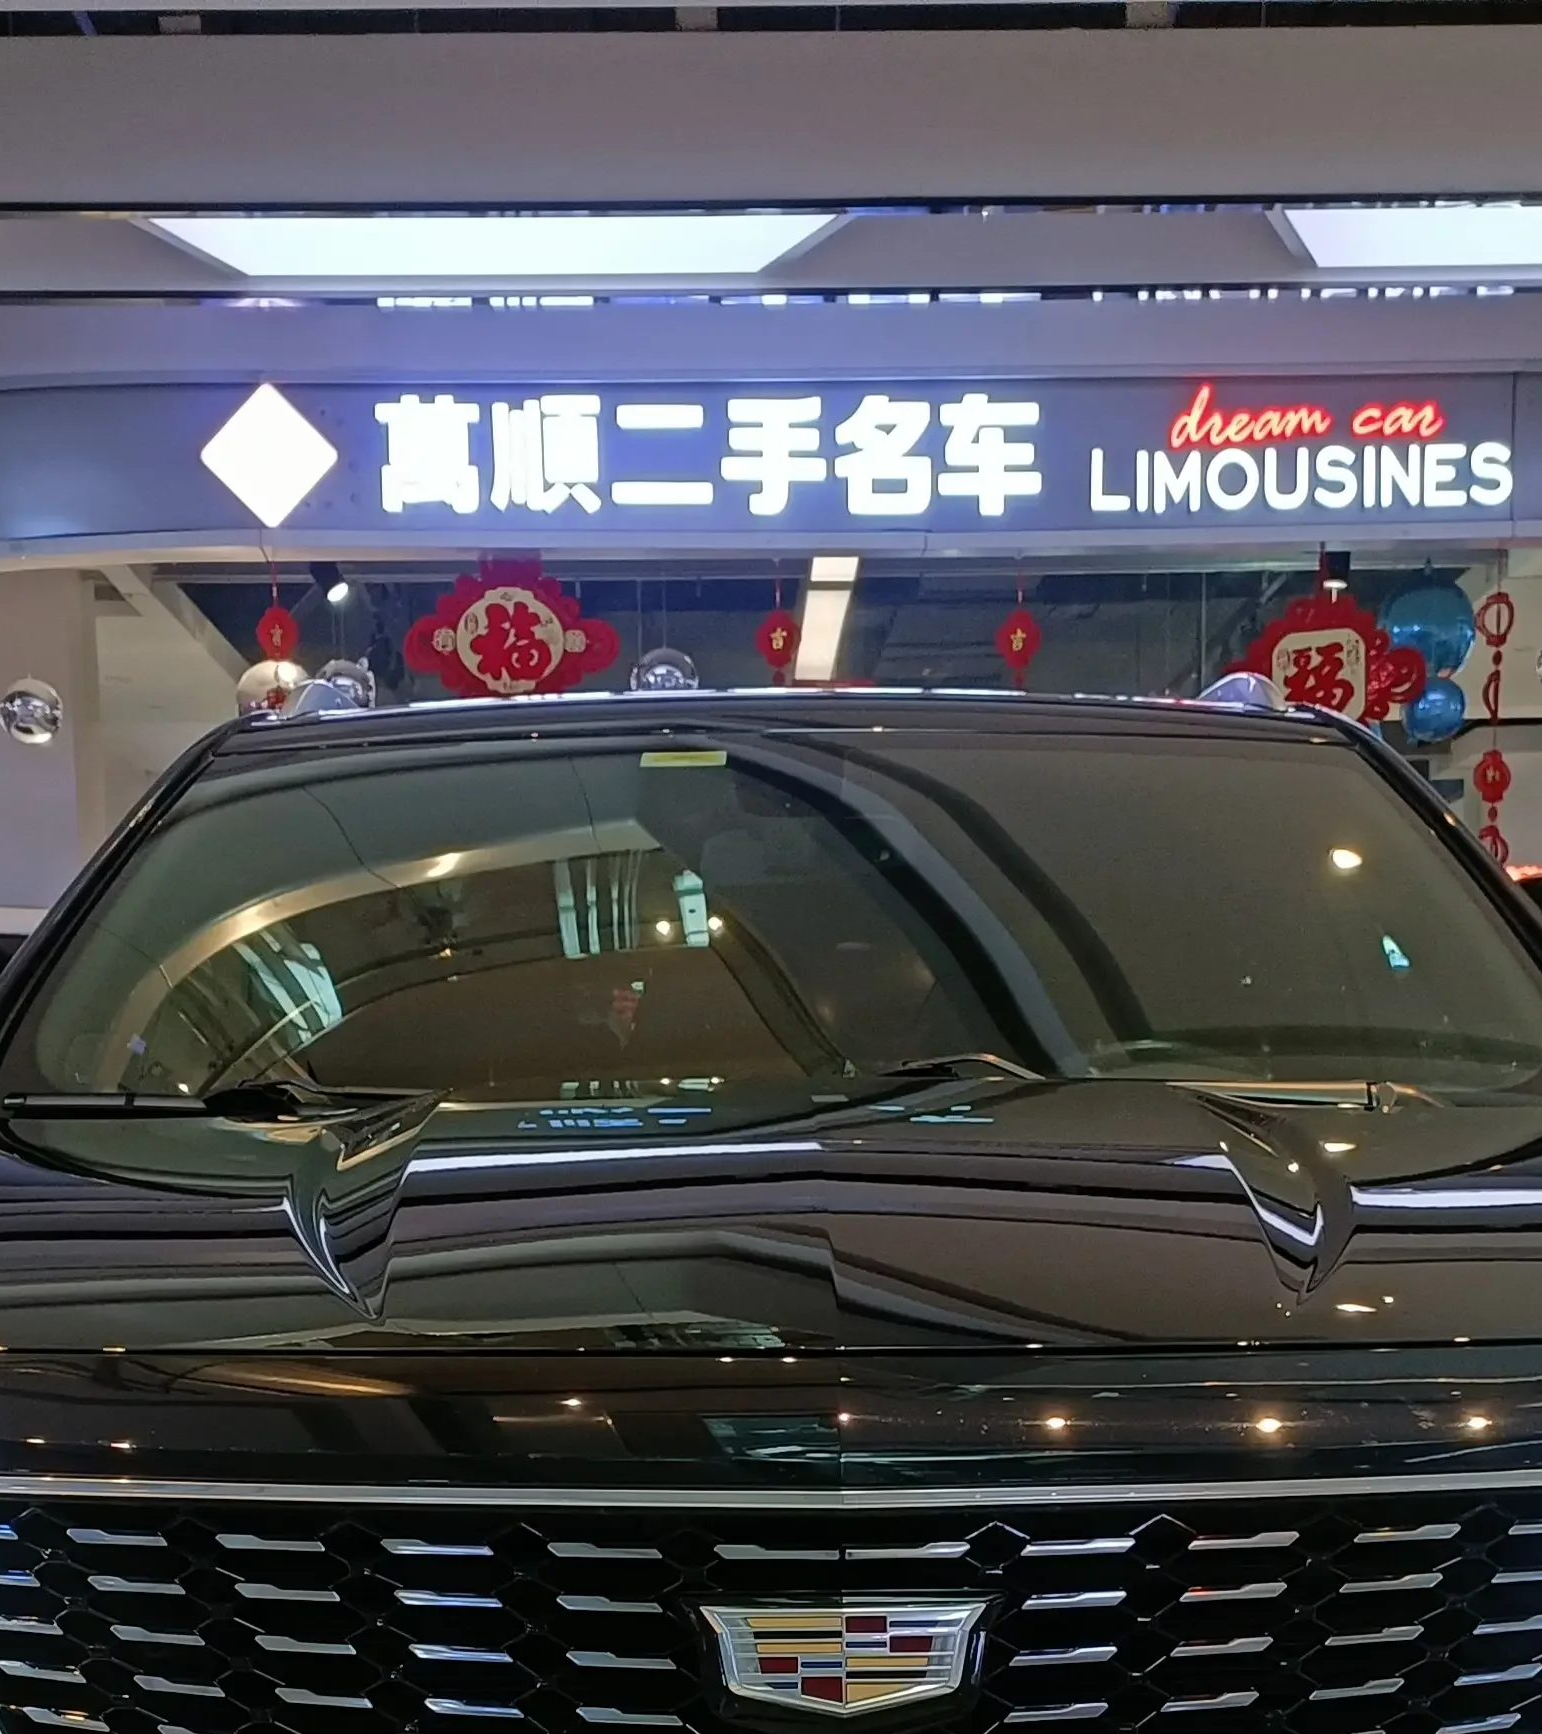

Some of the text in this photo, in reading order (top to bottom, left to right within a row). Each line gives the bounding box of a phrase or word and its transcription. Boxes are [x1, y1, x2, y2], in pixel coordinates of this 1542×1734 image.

[1170, 382, 1444, 449] dream car
[374, 393, 1042, 516] 萬順二手名车
[1089, 441, 1514, 514] LIMOUSINES
